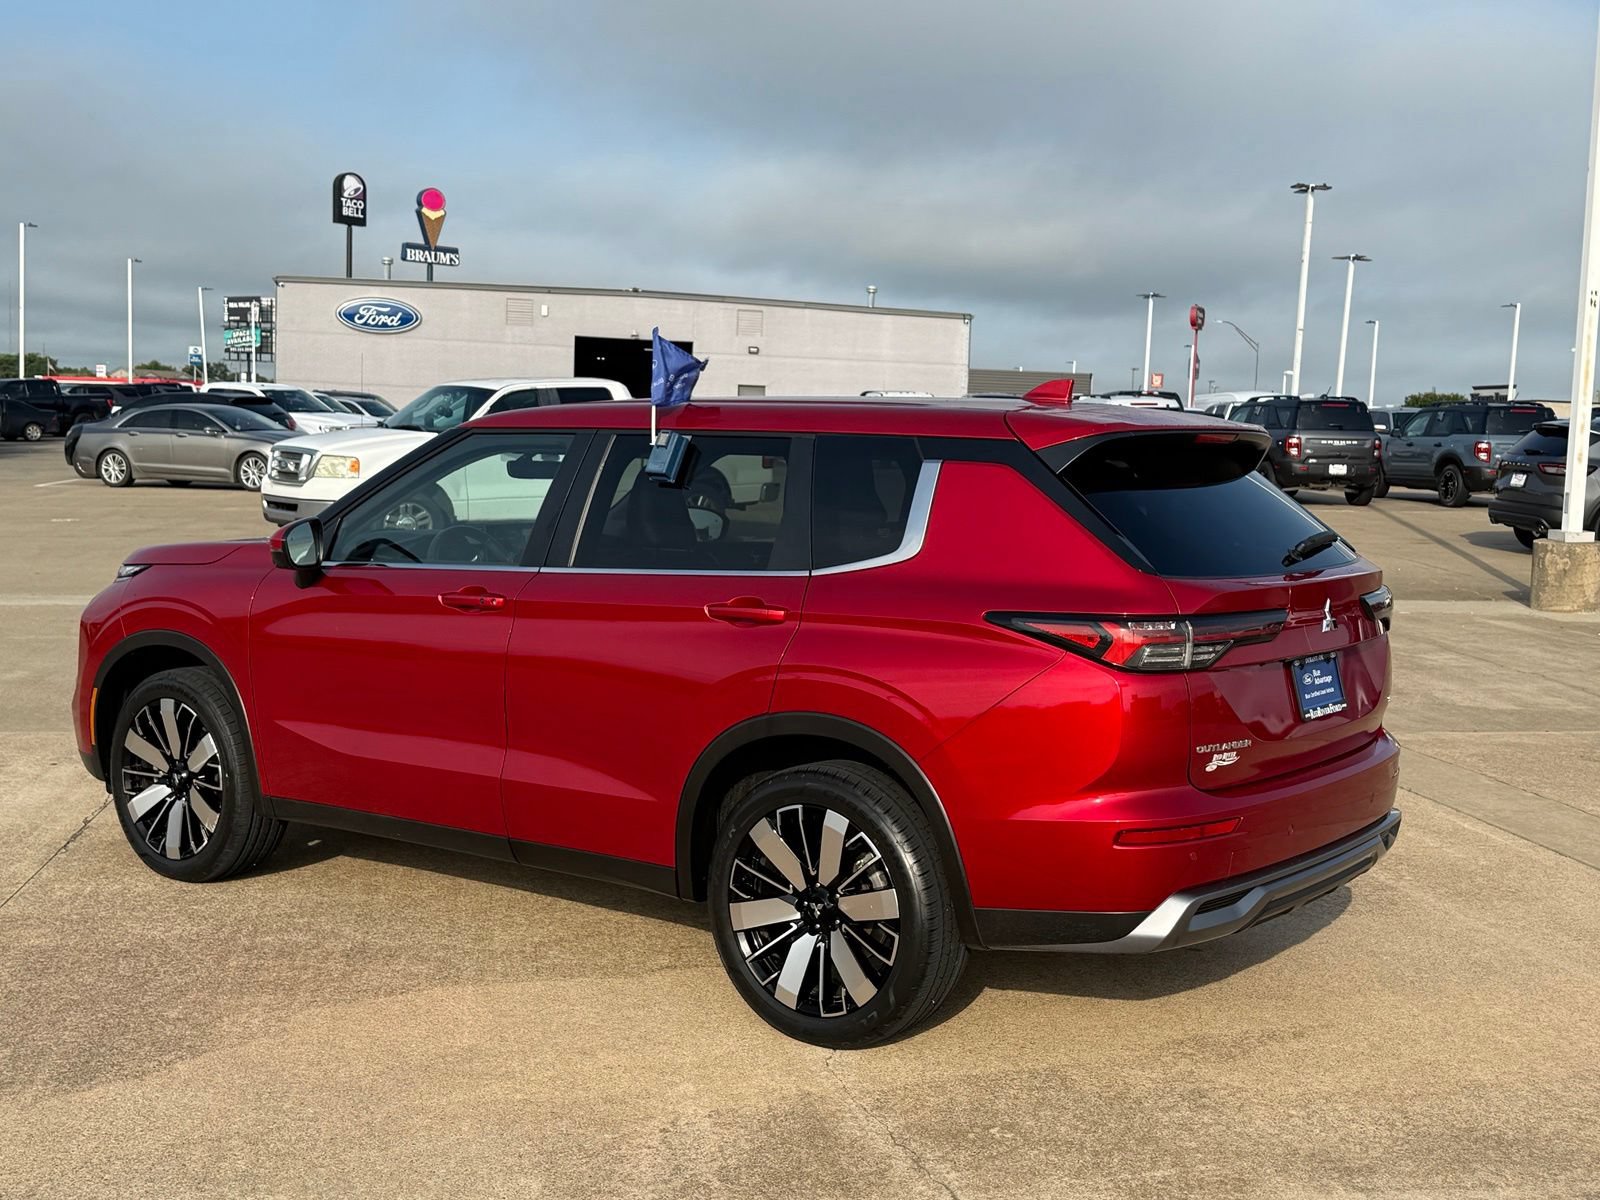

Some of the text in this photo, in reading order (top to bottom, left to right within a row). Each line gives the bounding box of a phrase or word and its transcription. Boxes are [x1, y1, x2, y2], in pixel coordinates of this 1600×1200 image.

[341, 198, 364, 209] TACO
[342, 208, 364, 218] BELL
[406, 248, 459, 265] BRAUM'S
[354, 305, 402, 326] Ford
[232, 330, 250, 338] SPACE
[227, 335, 256, 345] AVAILABL
[1314, 675, 1333, 685] Advantage
[1196, 739, 1252, 753] OUTLANDER
